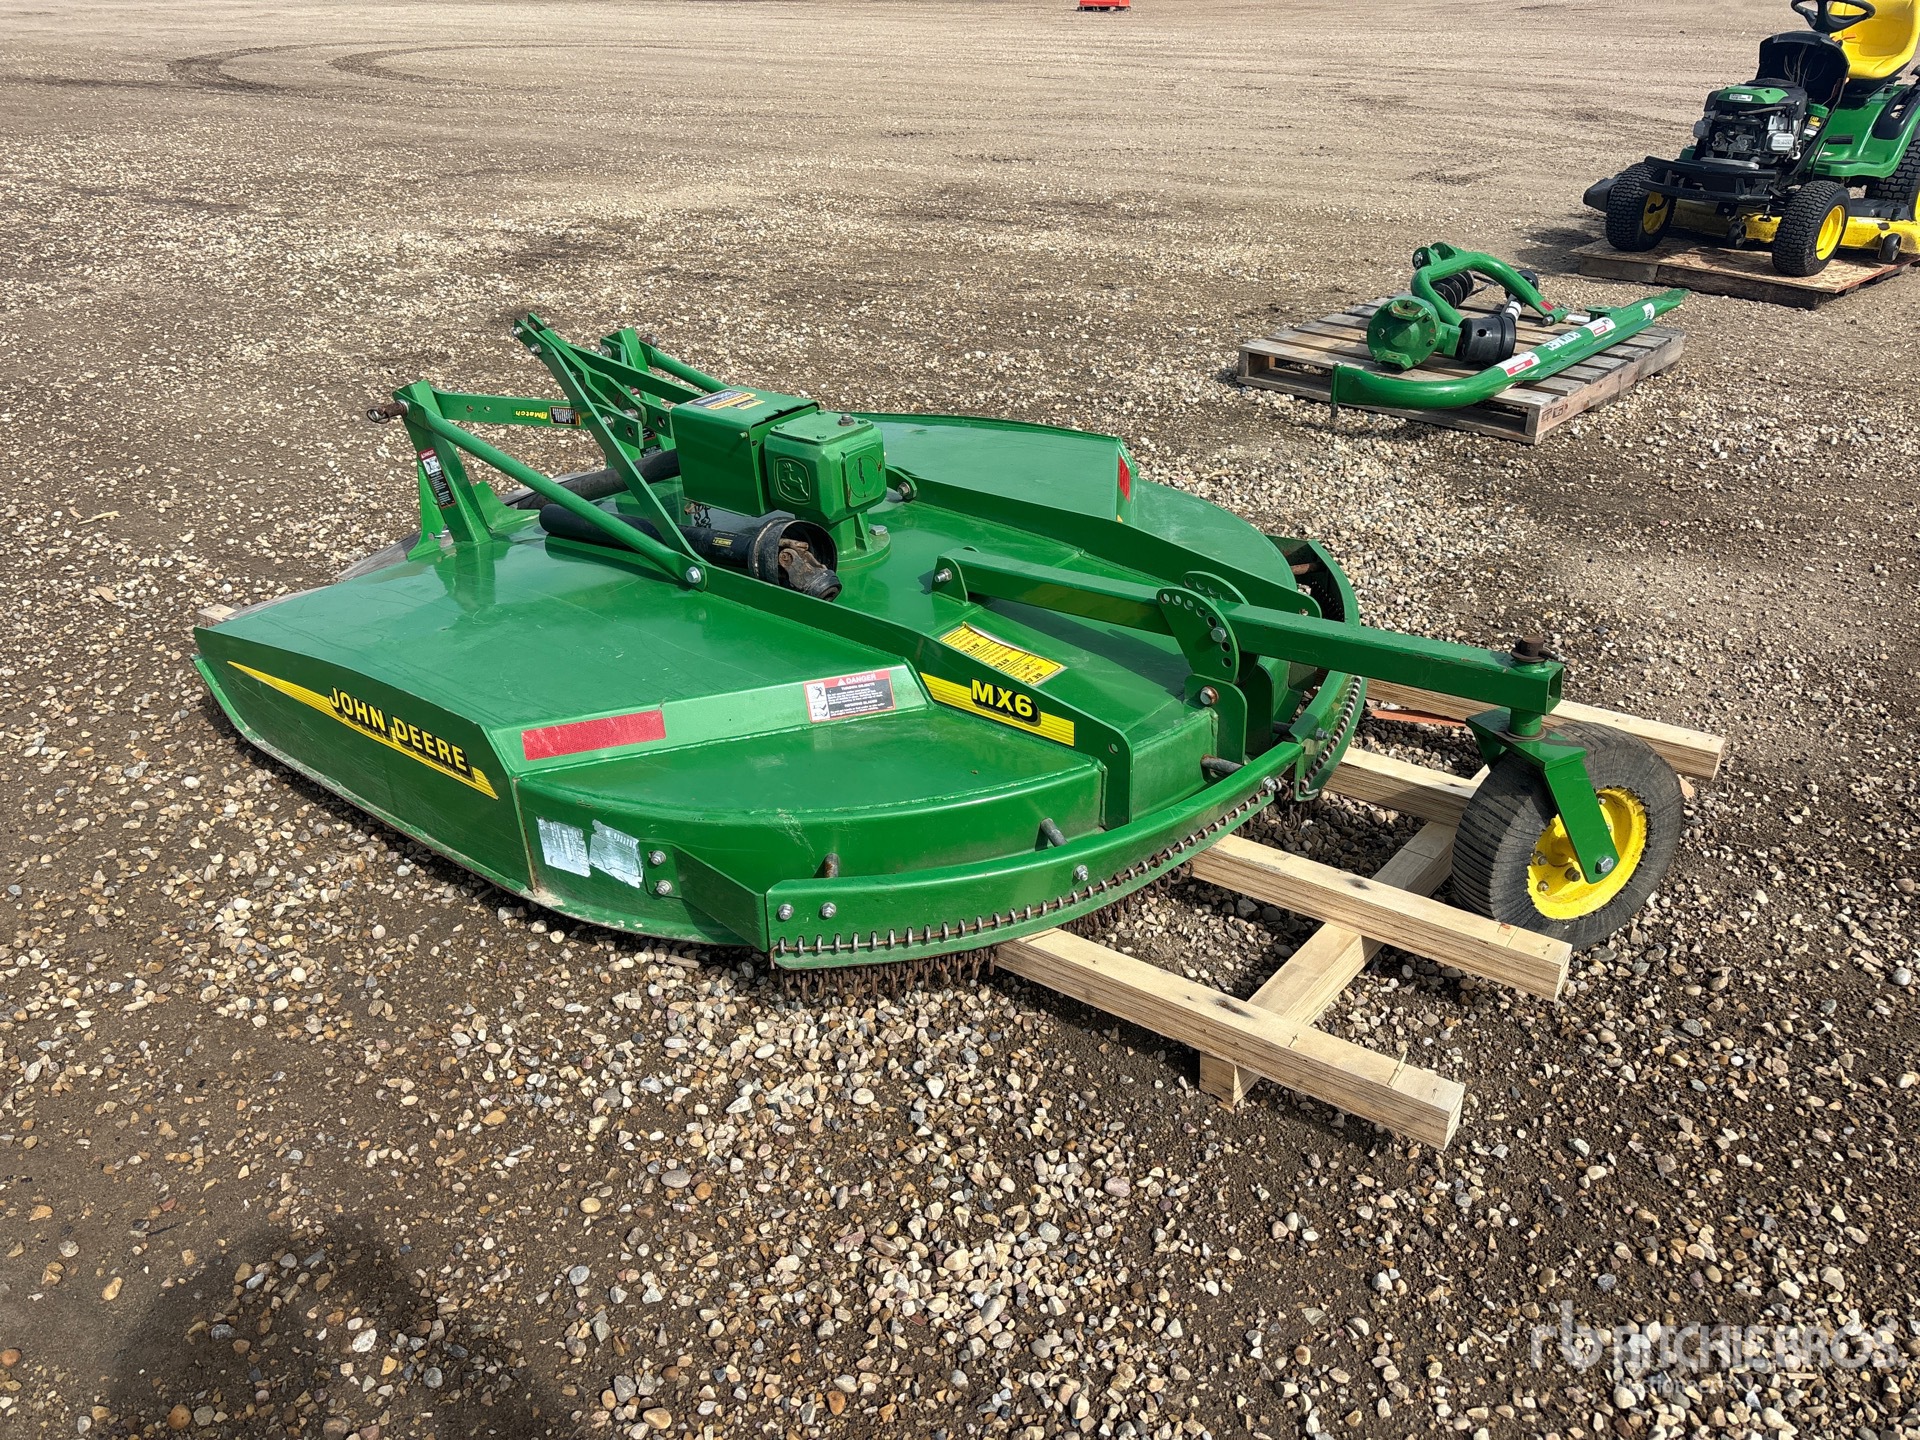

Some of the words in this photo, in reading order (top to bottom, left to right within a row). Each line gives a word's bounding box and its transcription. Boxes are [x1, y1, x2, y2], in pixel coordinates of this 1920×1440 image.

[846, 673, 877, 685] DANGER
[972, 679, 1033, 717] MX6
[329, 687, 387, 732] JOHN
[393, 716, 467, 772] DEERE
